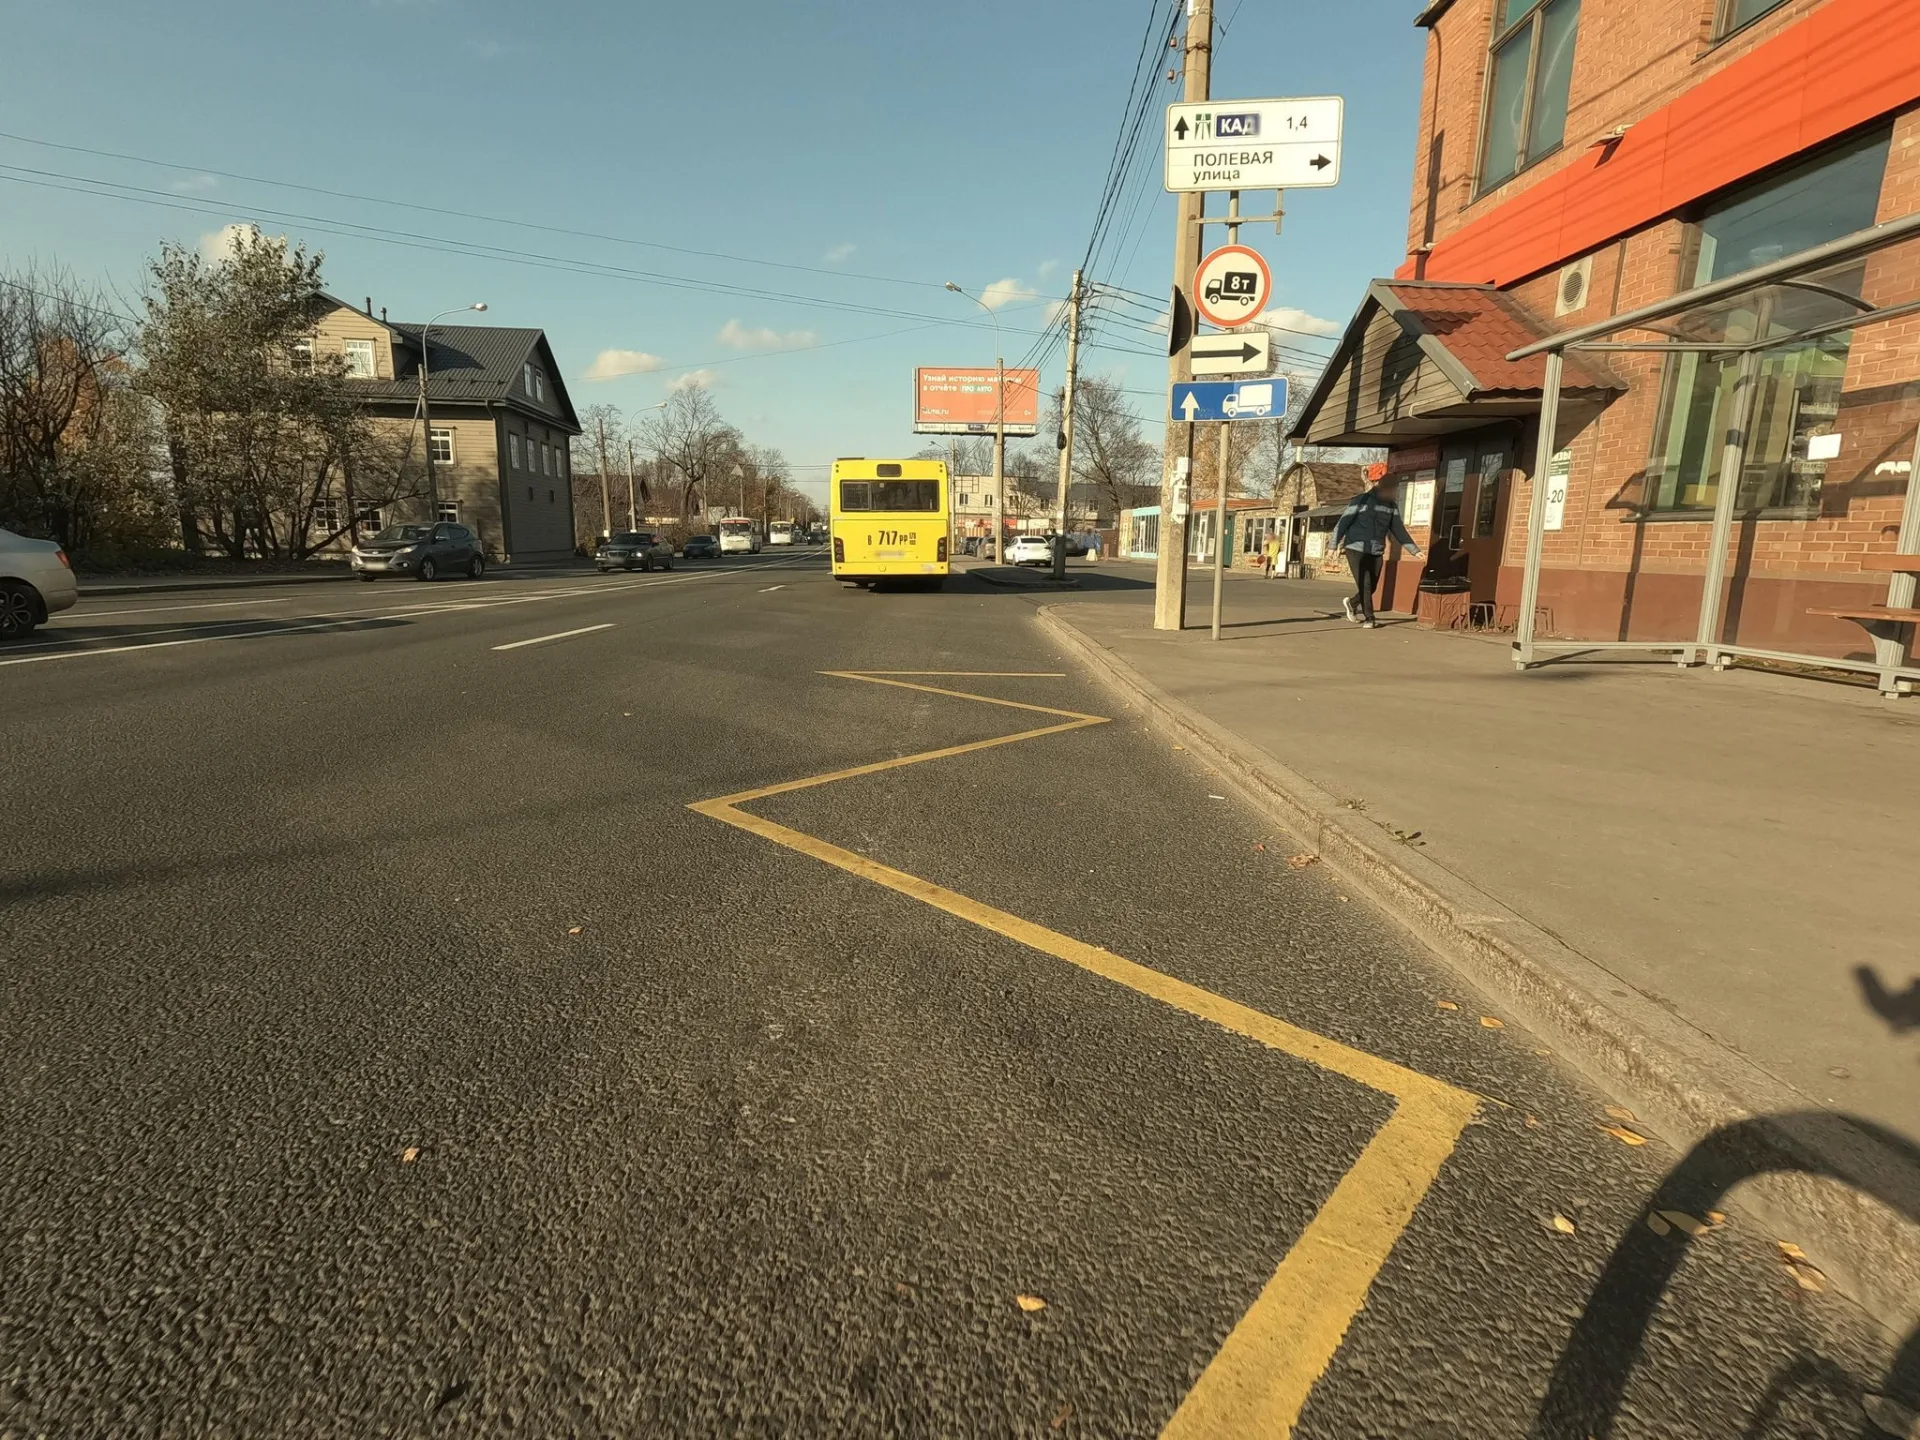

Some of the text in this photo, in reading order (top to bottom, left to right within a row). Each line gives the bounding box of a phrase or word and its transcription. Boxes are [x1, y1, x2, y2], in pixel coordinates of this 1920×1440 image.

[1286, 115, 1308, 131] 1,4
[1193, 151, 1273, 167] ПОЛЕВАЯ
[1193, 169, 1240, 184] улица
[923, 373, 947, 382] Узнай
[948, 375, 985, 383] историю
[929, 383, 957, 391] отчёте
[878, 530, 898, 545] 717
